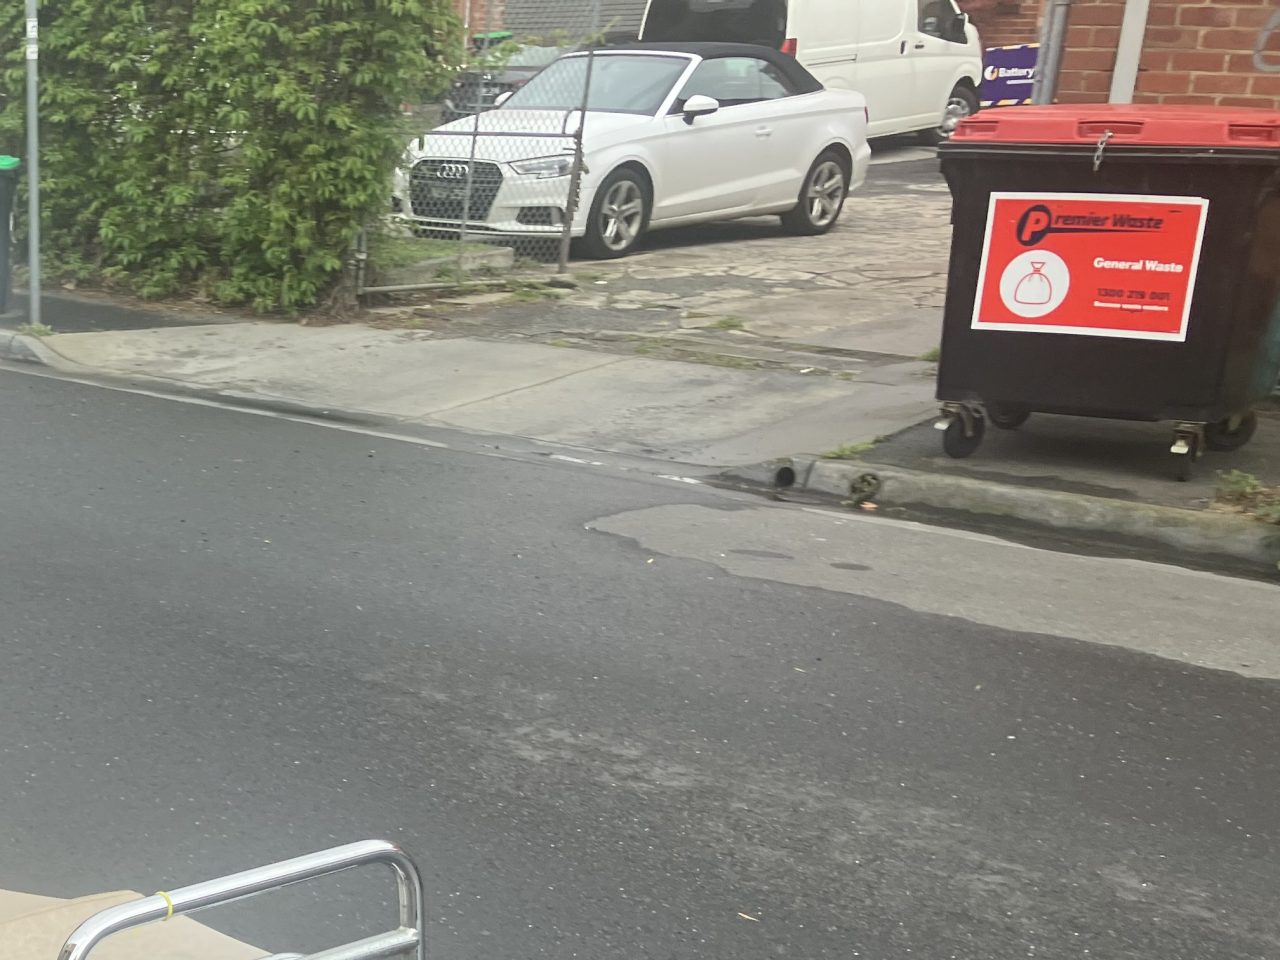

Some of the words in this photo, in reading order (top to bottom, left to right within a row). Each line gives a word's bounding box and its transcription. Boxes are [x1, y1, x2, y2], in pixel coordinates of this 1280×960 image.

[1018, 208, 1109, 243] Premier
[1112, 213, 1165, 230] Waste
[1093, 256, 1143, 271] General
[1145, 259, 1184, 273] Waste
